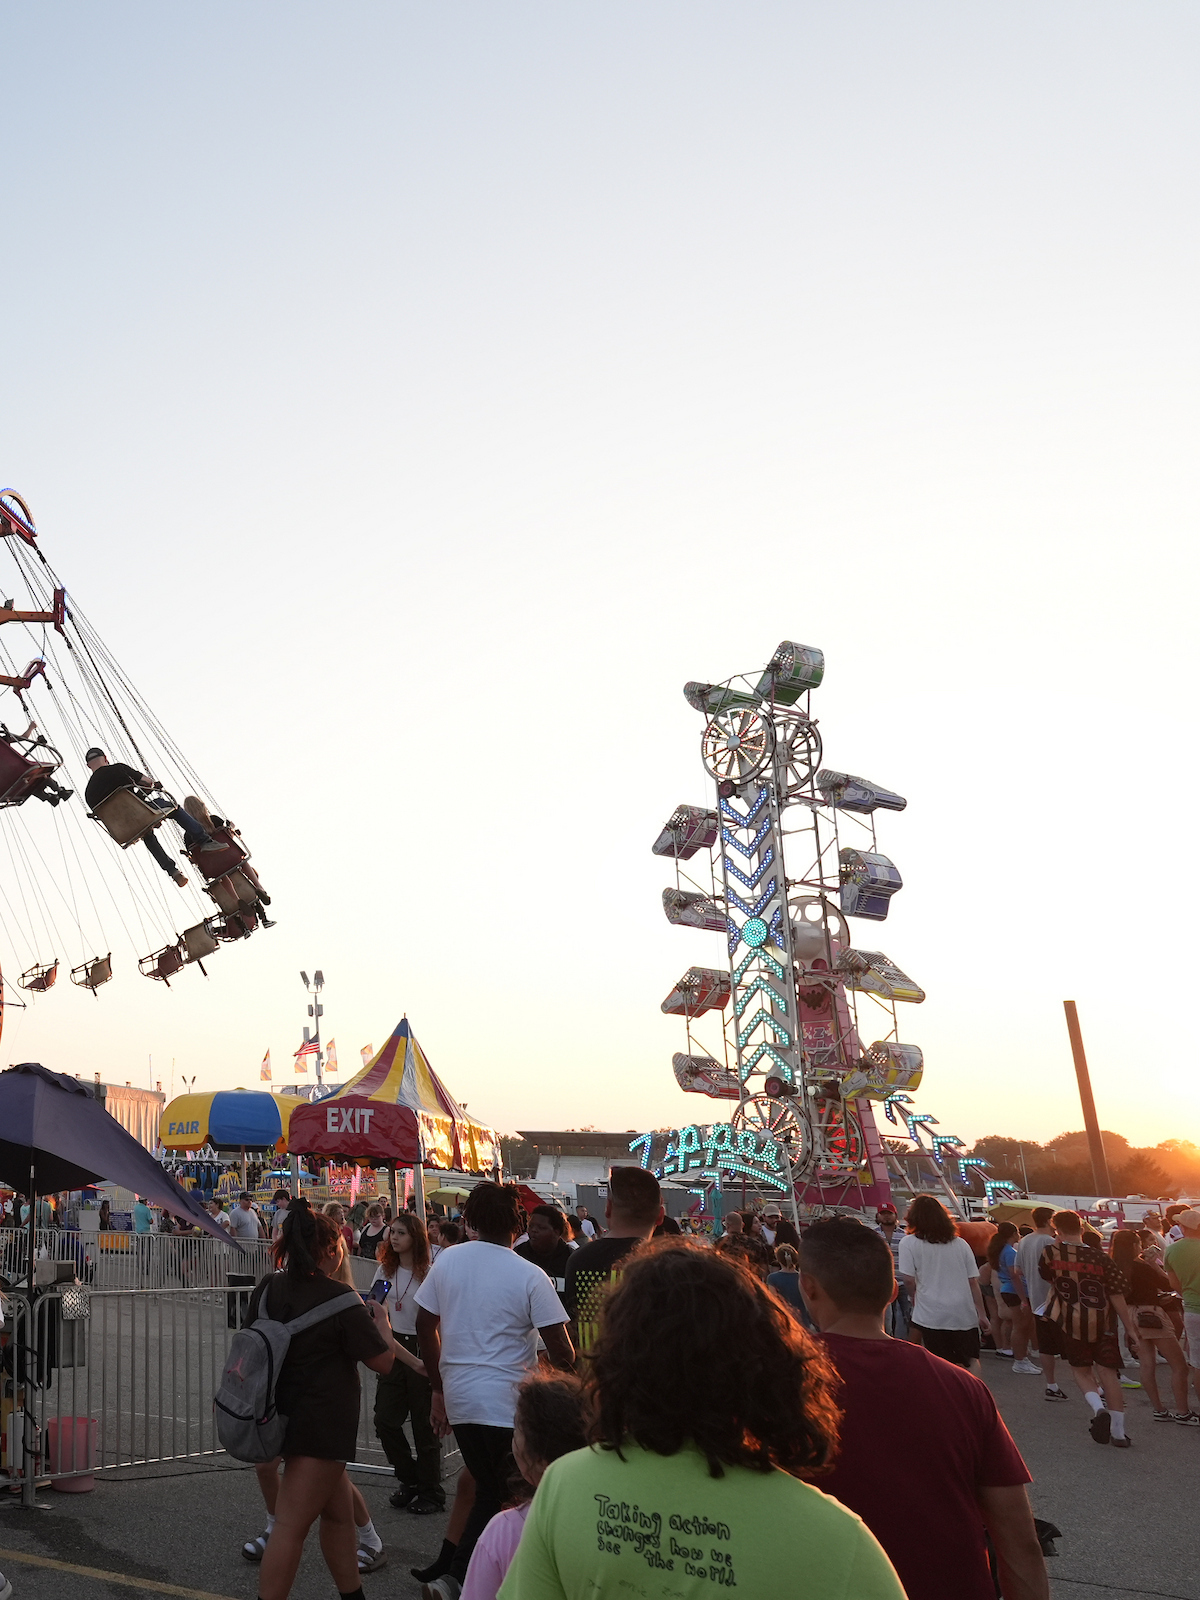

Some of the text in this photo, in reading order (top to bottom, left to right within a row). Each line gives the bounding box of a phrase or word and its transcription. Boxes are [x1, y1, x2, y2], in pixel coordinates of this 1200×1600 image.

[168, 1120, 200, 1136] FAIR
[326, 1107, 375, 1134] EXIT
[1053, 1276, 1109, 1311] 99
[594, 1494, 731, 1540] Taking action
[643, 1550, 674, 1571] the
[669, 1537, 704, 1561] how
[711, 1549, 733, 1567] we
